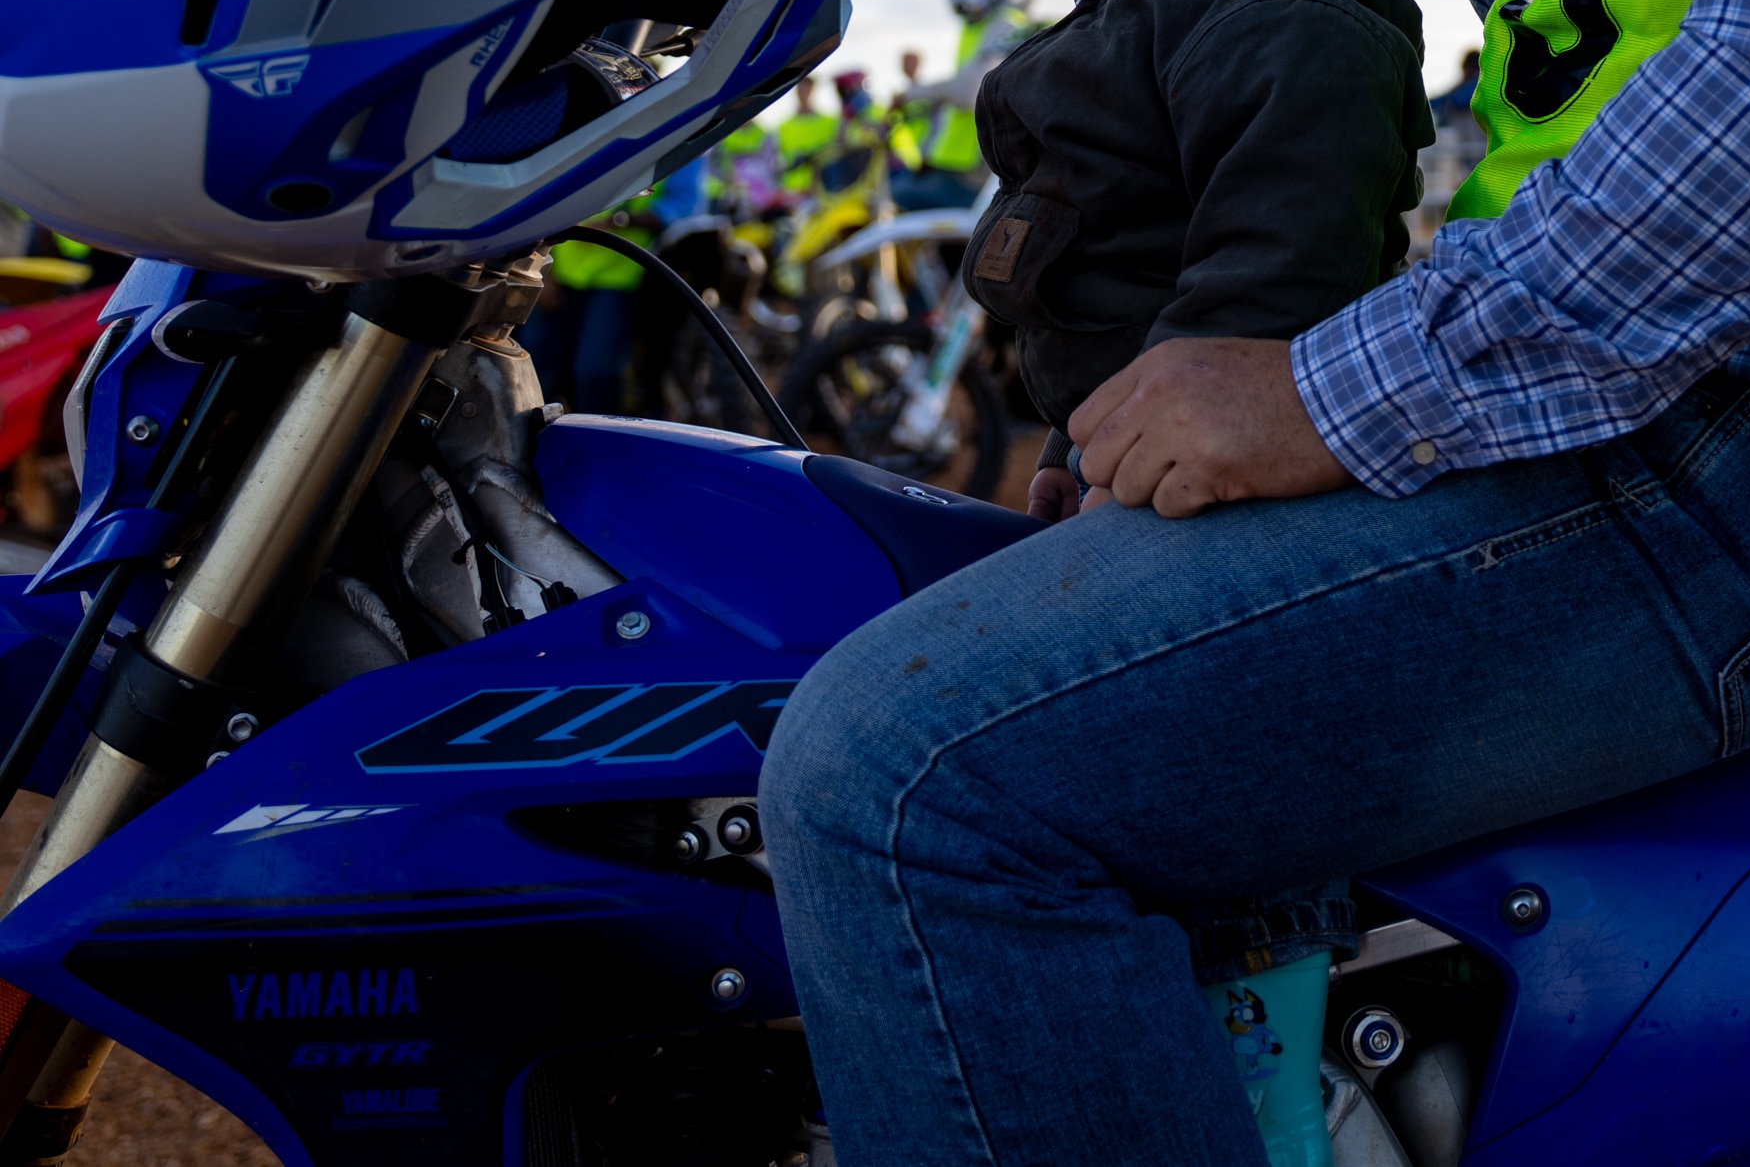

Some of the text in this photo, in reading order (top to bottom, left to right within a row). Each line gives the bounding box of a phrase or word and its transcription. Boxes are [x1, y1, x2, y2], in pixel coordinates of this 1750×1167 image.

[470, 22, 512, 67] RHE
[225, 966, 419, 1021] YAMAHA
[287, 1039, 437, 1069] GYTR
[341, 1086, 443, 1115] YAMALUBE
